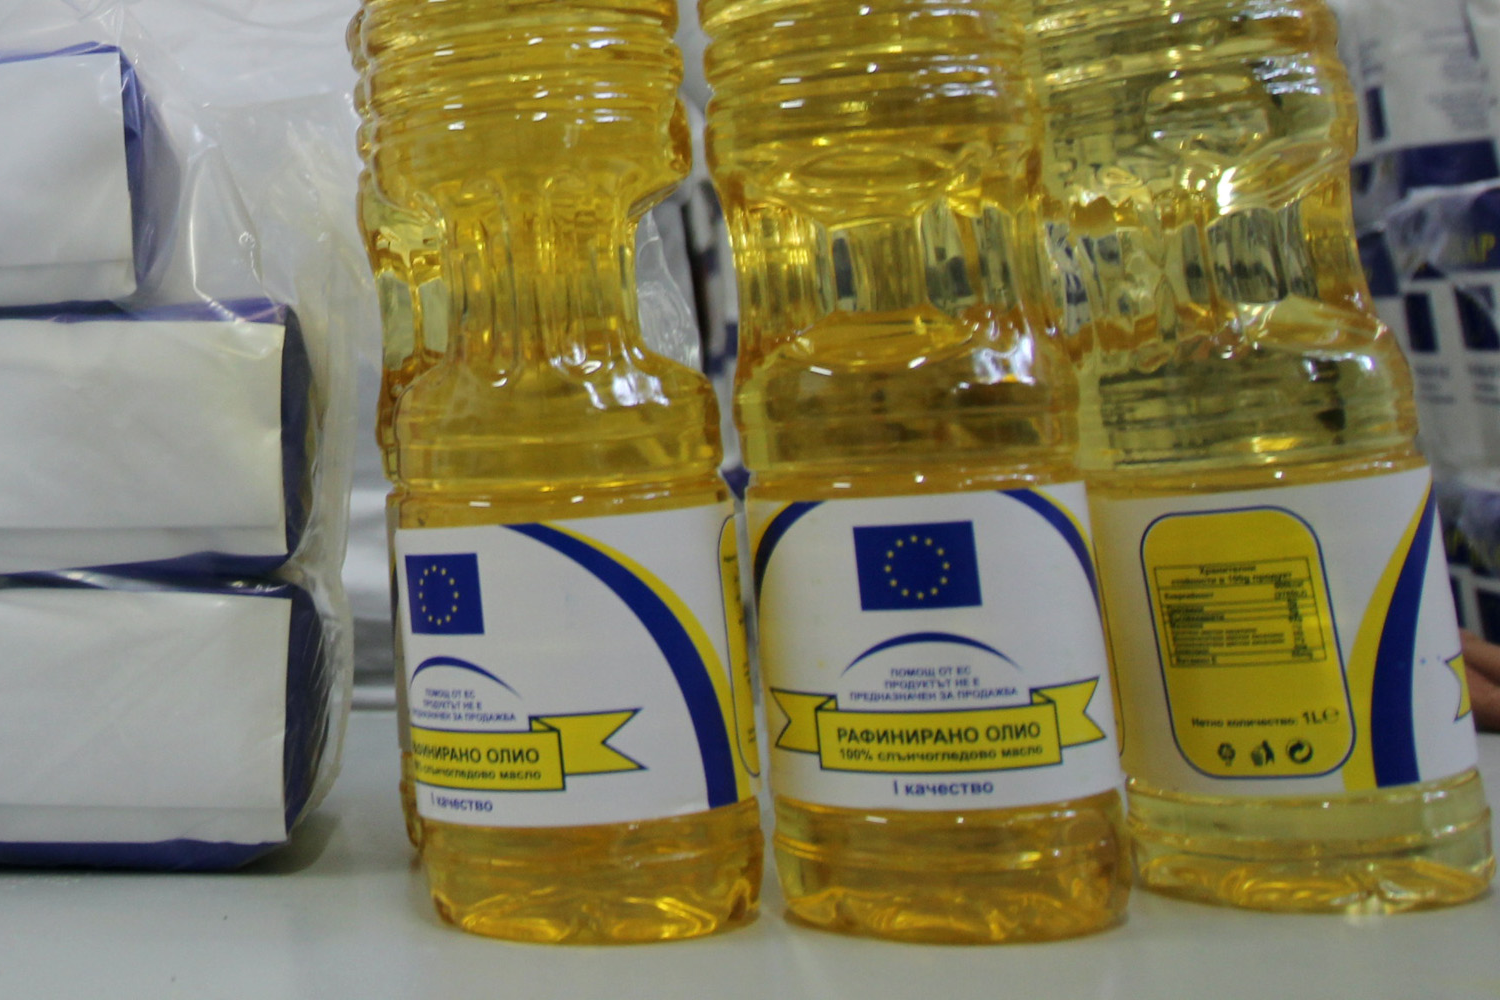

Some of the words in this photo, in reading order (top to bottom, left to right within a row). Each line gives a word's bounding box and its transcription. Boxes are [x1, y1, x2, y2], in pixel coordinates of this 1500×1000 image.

[891, 667, 935, 678] ПОМОЩ
[938, 667, 953, 676] ОТ
[957, 665, 971, 675] ЕС
[884, 678, 953, 690] ПРОДУКТЪТ
[955, 678, 969, 687] НЕ
[973, 677, 980, 686] Е
[850, 690, 936, 701] ПРЕДНАЗНАЧЕН
[940, 691, 953, 699] ЗА
[957, 686, 1017, 700] ПРОДАЖБА
[837, 726, 979, 745] РАФИНИРАНО
[985, 721, 1041, 742] ОЛИО
[486, 747, 540, 764] ОЛИО
[840, 748, 873, 761] 100%
[878, 749, 997, 763] слънчогледово
[1002, 745, 1043, 758] масло
[500, 770, 541, 780] масло
[905, 781, 994, 796] качество
